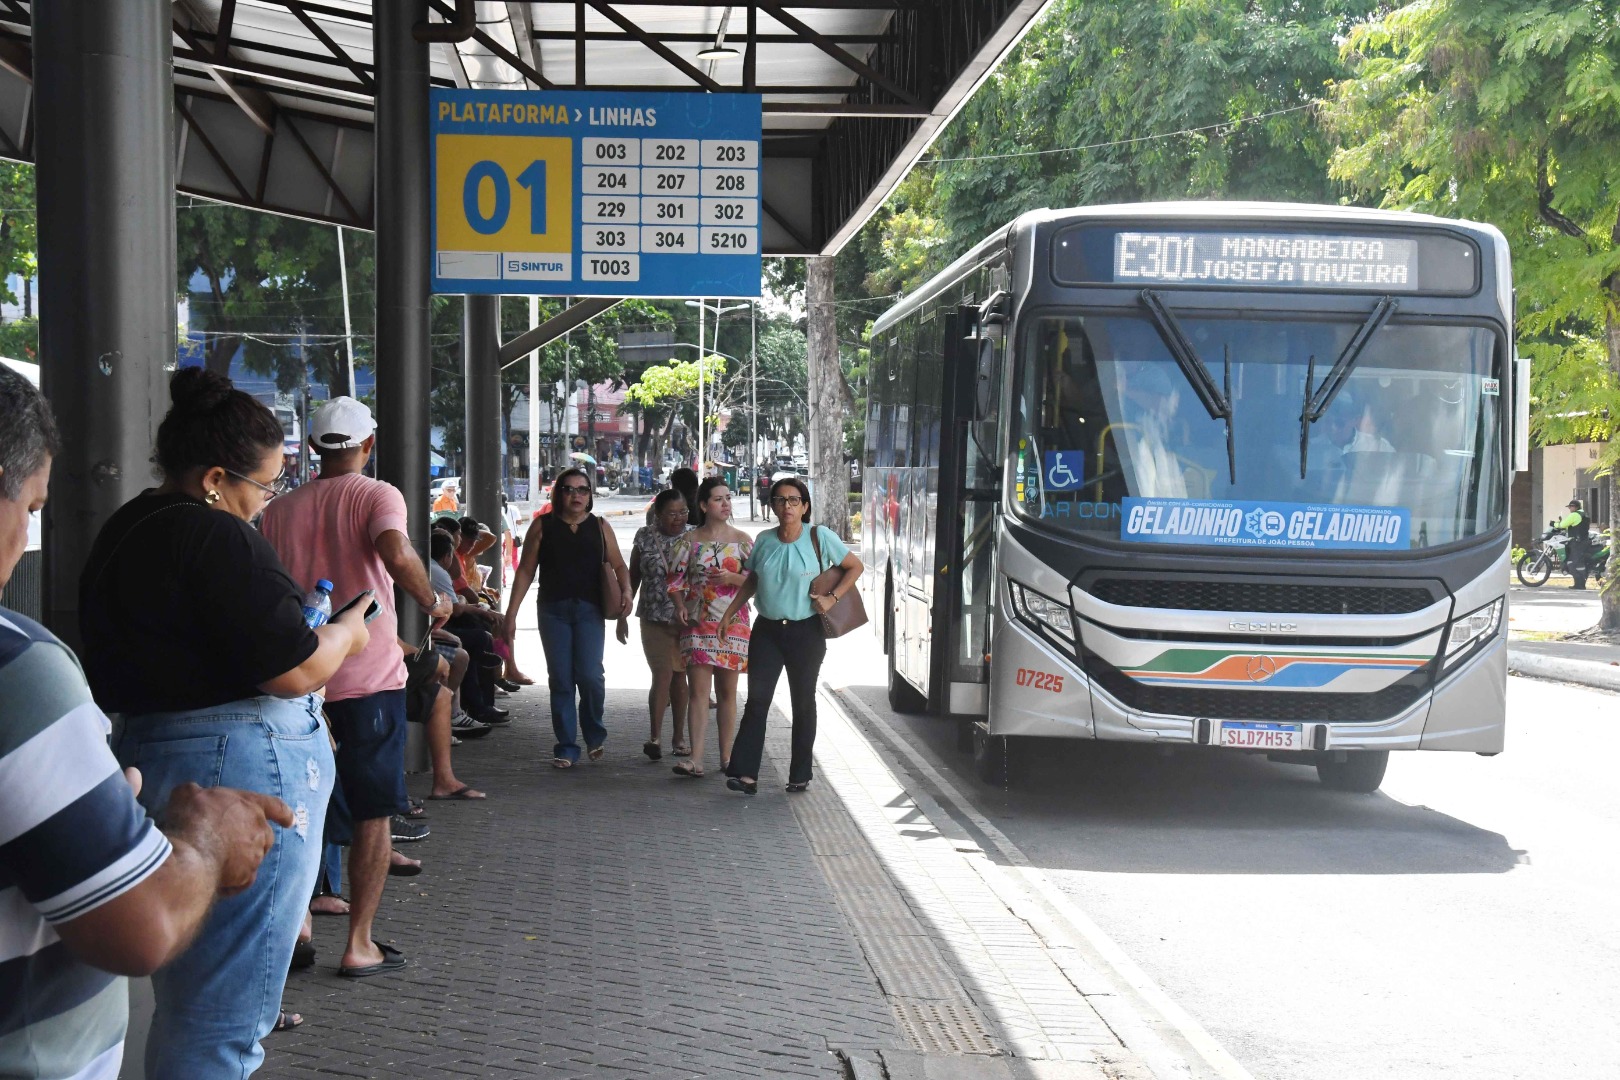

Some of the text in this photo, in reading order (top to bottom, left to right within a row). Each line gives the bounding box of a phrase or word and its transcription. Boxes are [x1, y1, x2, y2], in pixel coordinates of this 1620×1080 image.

[438, 102, 657, 127] PLATAFORMA LINHAS
[595, 143, 746, 162] 003 202 203
[597, 173, 745, 191] 204 207 208
[462, 159, 547, 236] 01
[597, 202, 744, 220] 229 301 302
[595, 231, 748, 249] 303 304 5210
[1222, 237, 1384, 260] MANGABEIRA
[1119, 234, 1197, 278] E301
[520, 262, 564, 272] SINTUR
[590, 259, 631, 276] T003
[1198, 259, 1408, 284] JOSEFA TAVEIRA
[1126, 505, 1243, 537] GELADINHO
[1287, 511, 1402, 544] GELADINHO
[1214, 537, 1257, 545] PREFEITURA
[1267, 538, 1287, 546] JOÃO
[1016, 668, 1065, 693] 07225
[1227, 730, 1293, 747] SLD7H53
